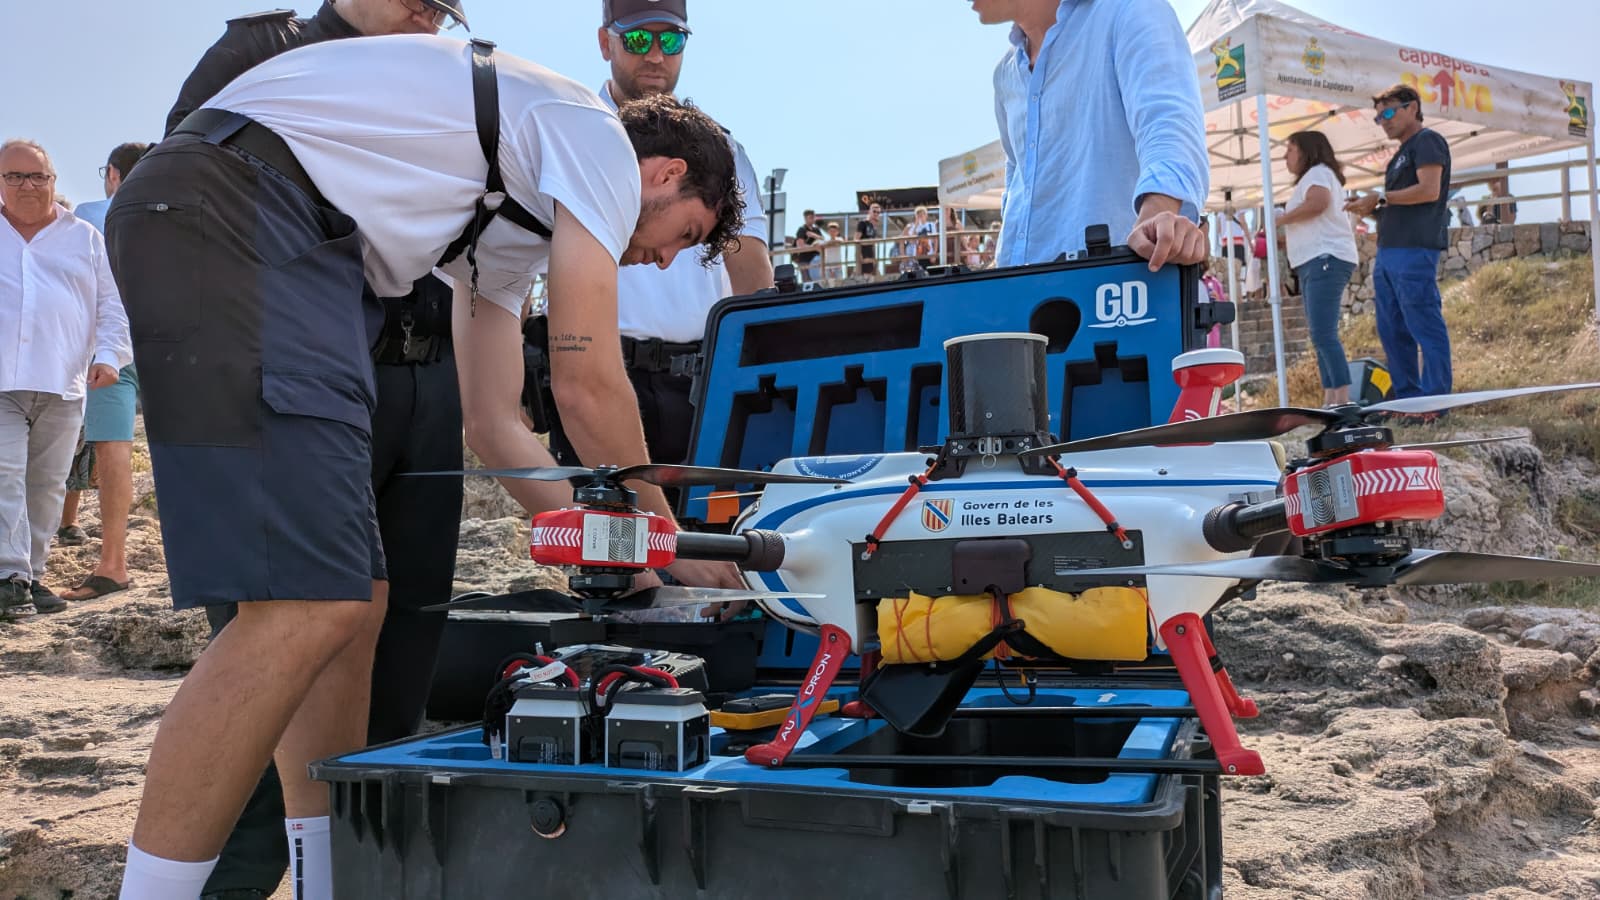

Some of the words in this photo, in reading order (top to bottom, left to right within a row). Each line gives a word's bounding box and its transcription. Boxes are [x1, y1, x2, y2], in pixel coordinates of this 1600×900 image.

[1095, 280, 1148, 322] GD
[962, 501, 1009, 511] Govern
[1013, 499, 1030, 509] de
[1034, 499, 1054, 508] les
[961, 513, 991, 526] Illes
[997, 512, 1053, 525] Balears
